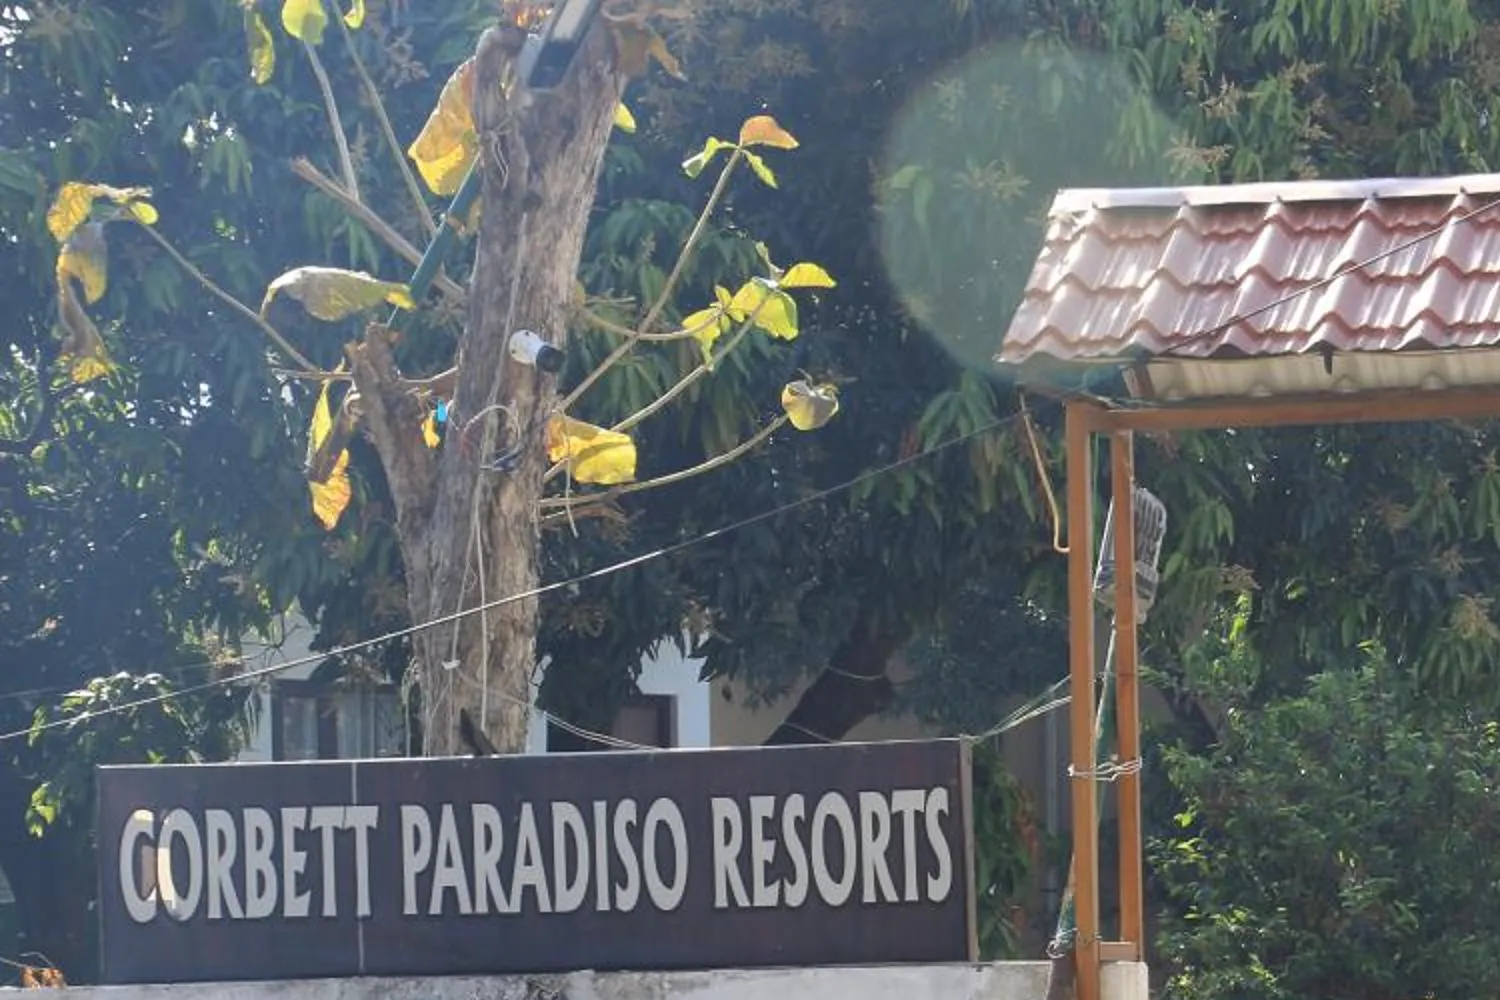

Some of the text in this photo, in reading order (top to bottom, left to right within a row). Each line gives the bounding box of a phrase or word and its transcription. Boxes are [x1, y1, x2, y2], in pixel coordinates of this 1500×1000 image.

[119, 786, 953, 923] CORBETT PARADISO RESORTS
